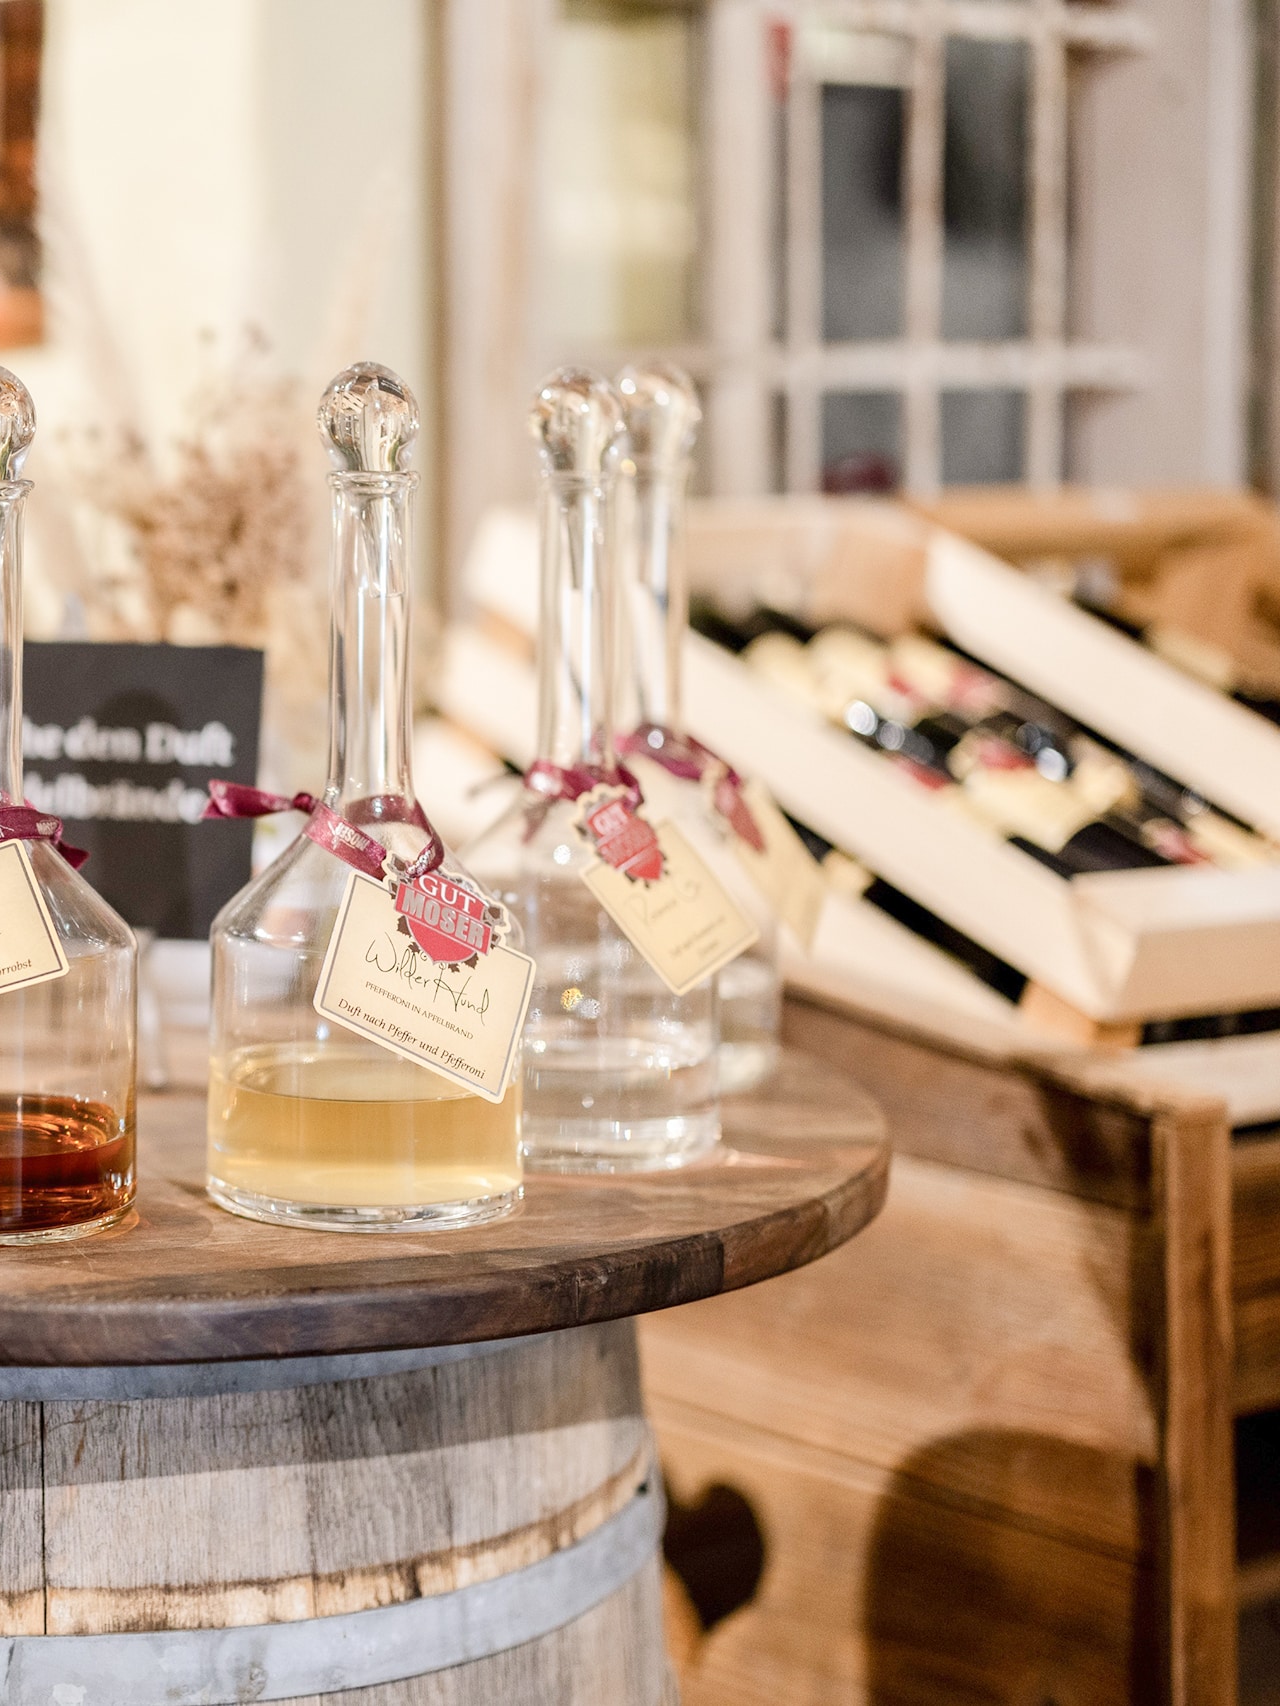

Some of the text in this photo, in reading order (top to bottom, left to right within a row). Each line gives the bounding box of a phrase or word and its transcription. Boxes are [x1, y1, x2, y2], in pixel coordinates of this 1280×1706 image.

[335, 822, 370, 851] MOSER
[401, 888, 485, 949] MOSER
[419, 874, 477, 914] GUT
[365, 931, 490, 1026] Wilder Hund
[338, 998, 486, 1079] Duft nach Pfeffer und Pfefferoni
[365, 981, 474, 1040] PFEFFERONI IN APFELBRAND
